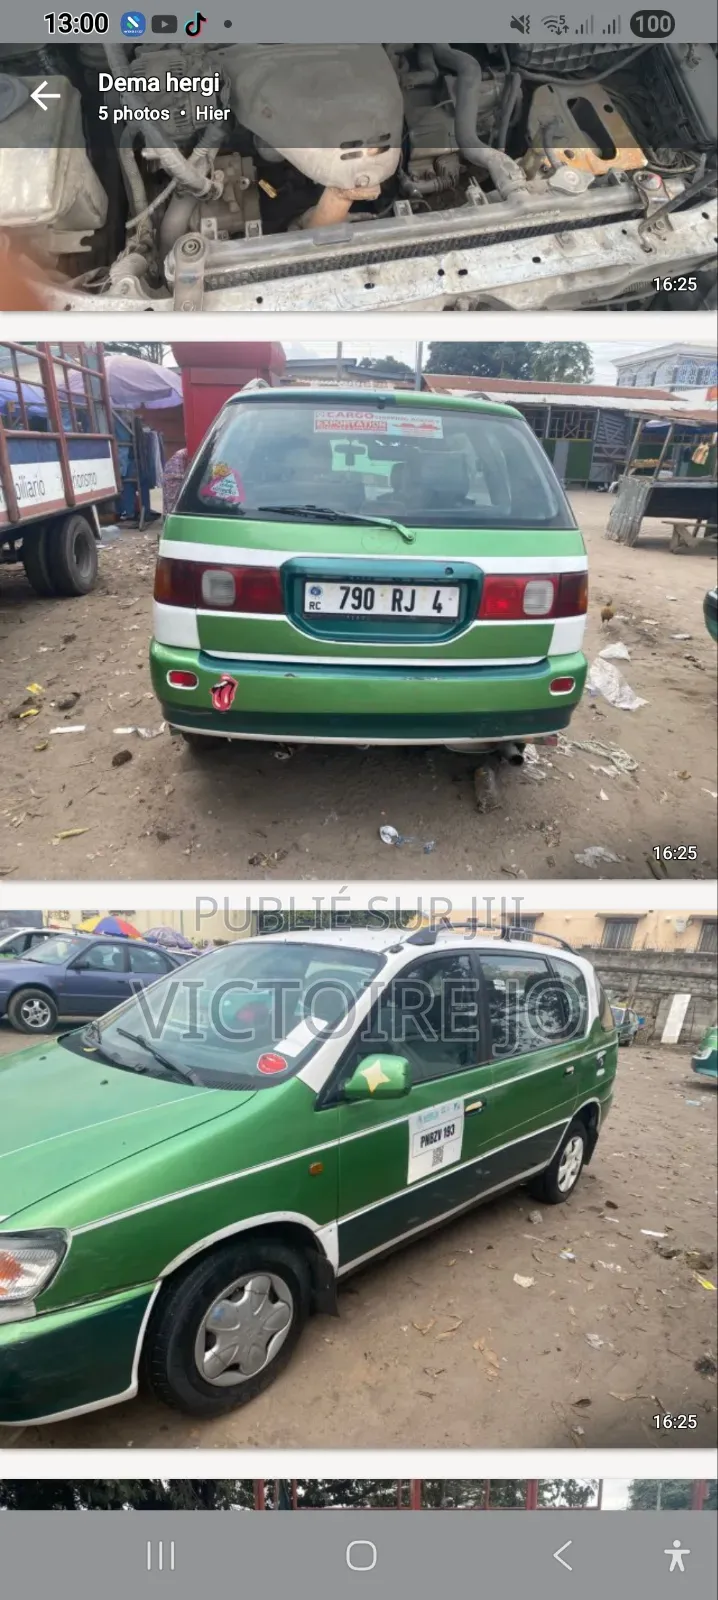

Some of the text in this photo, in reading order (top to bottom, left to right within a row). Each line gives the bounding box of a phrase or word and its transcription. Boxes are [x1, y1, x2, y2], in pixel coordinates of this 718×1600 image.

[44, 12, 109, 34] 13:00
[559, 14, 566, 25] 5
[635, 15, 672, 33] 100
[98, 72, 220, 95] Dema hergi
[98, 106, 230, 123] 5 photos Hier
[653, 276, 698, 292] 16:25
[309, 602, 321, 611] RC
[339, 586, 443, 614] 790 RJ 4
[653, 845, 698, 861] 16:25
[653, 1414, 698, 1430] 16:25
